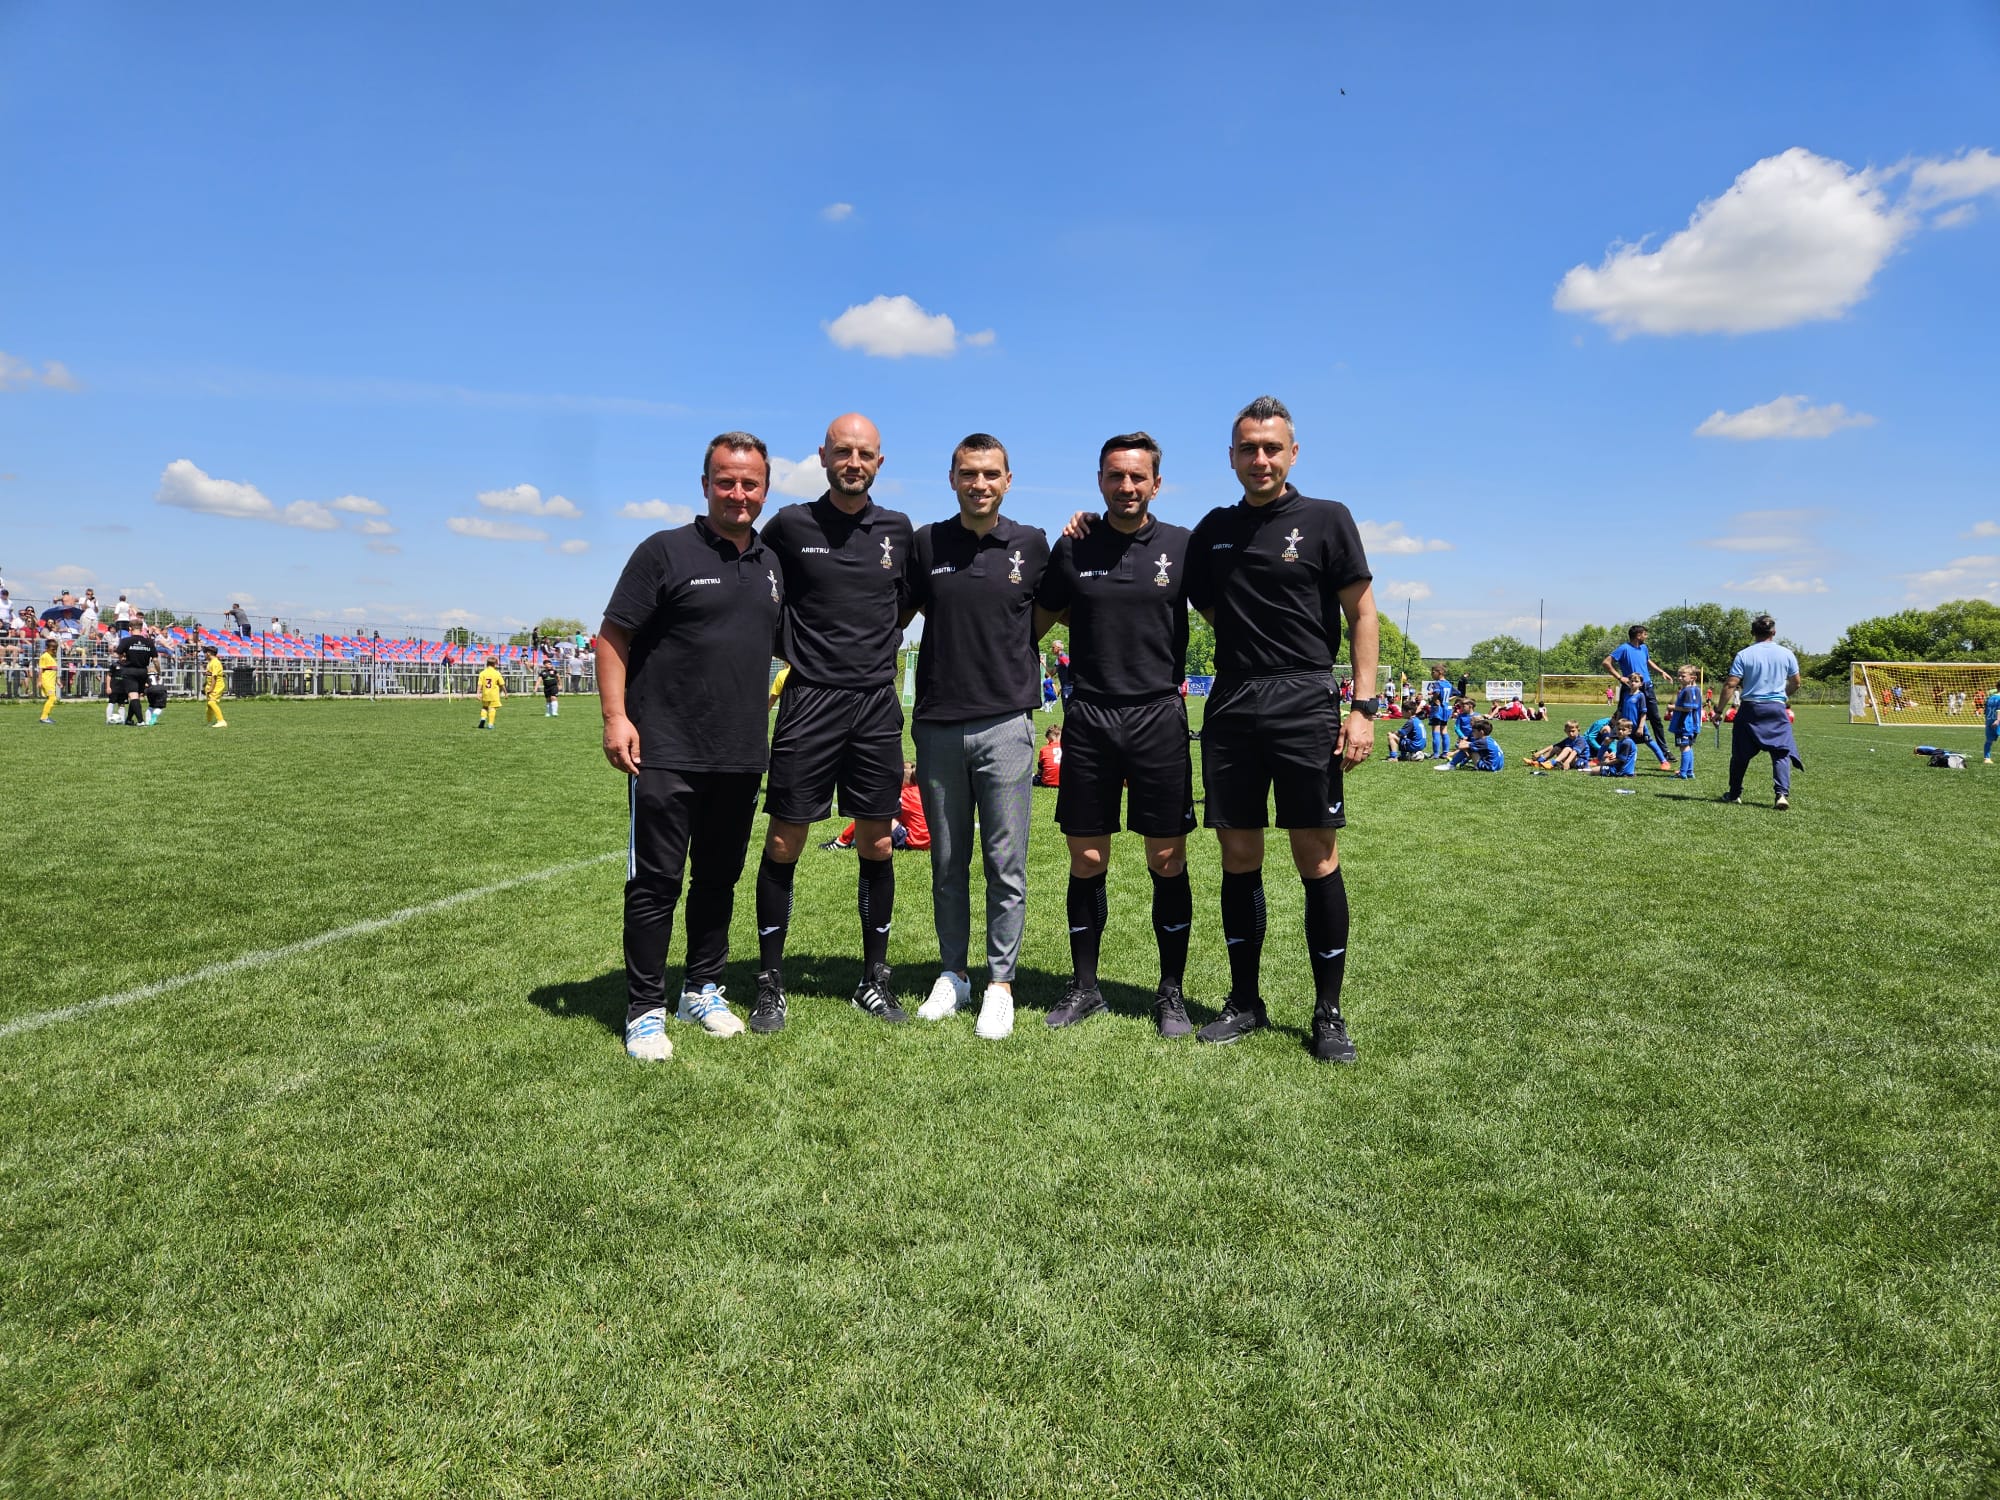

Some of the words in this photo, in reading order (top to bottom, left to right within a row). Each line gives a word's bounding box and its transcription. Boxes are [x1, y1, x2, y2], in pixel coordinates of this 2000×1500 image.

[801, 546, 829, 554] ARBITRU
[930, 566, 956, 575] ARBITRU
[1079, 567, 1108, 576] ARBITRU
[690, 577, 721, 586] ARBITRU
[485, 678, 492, 689] 3
